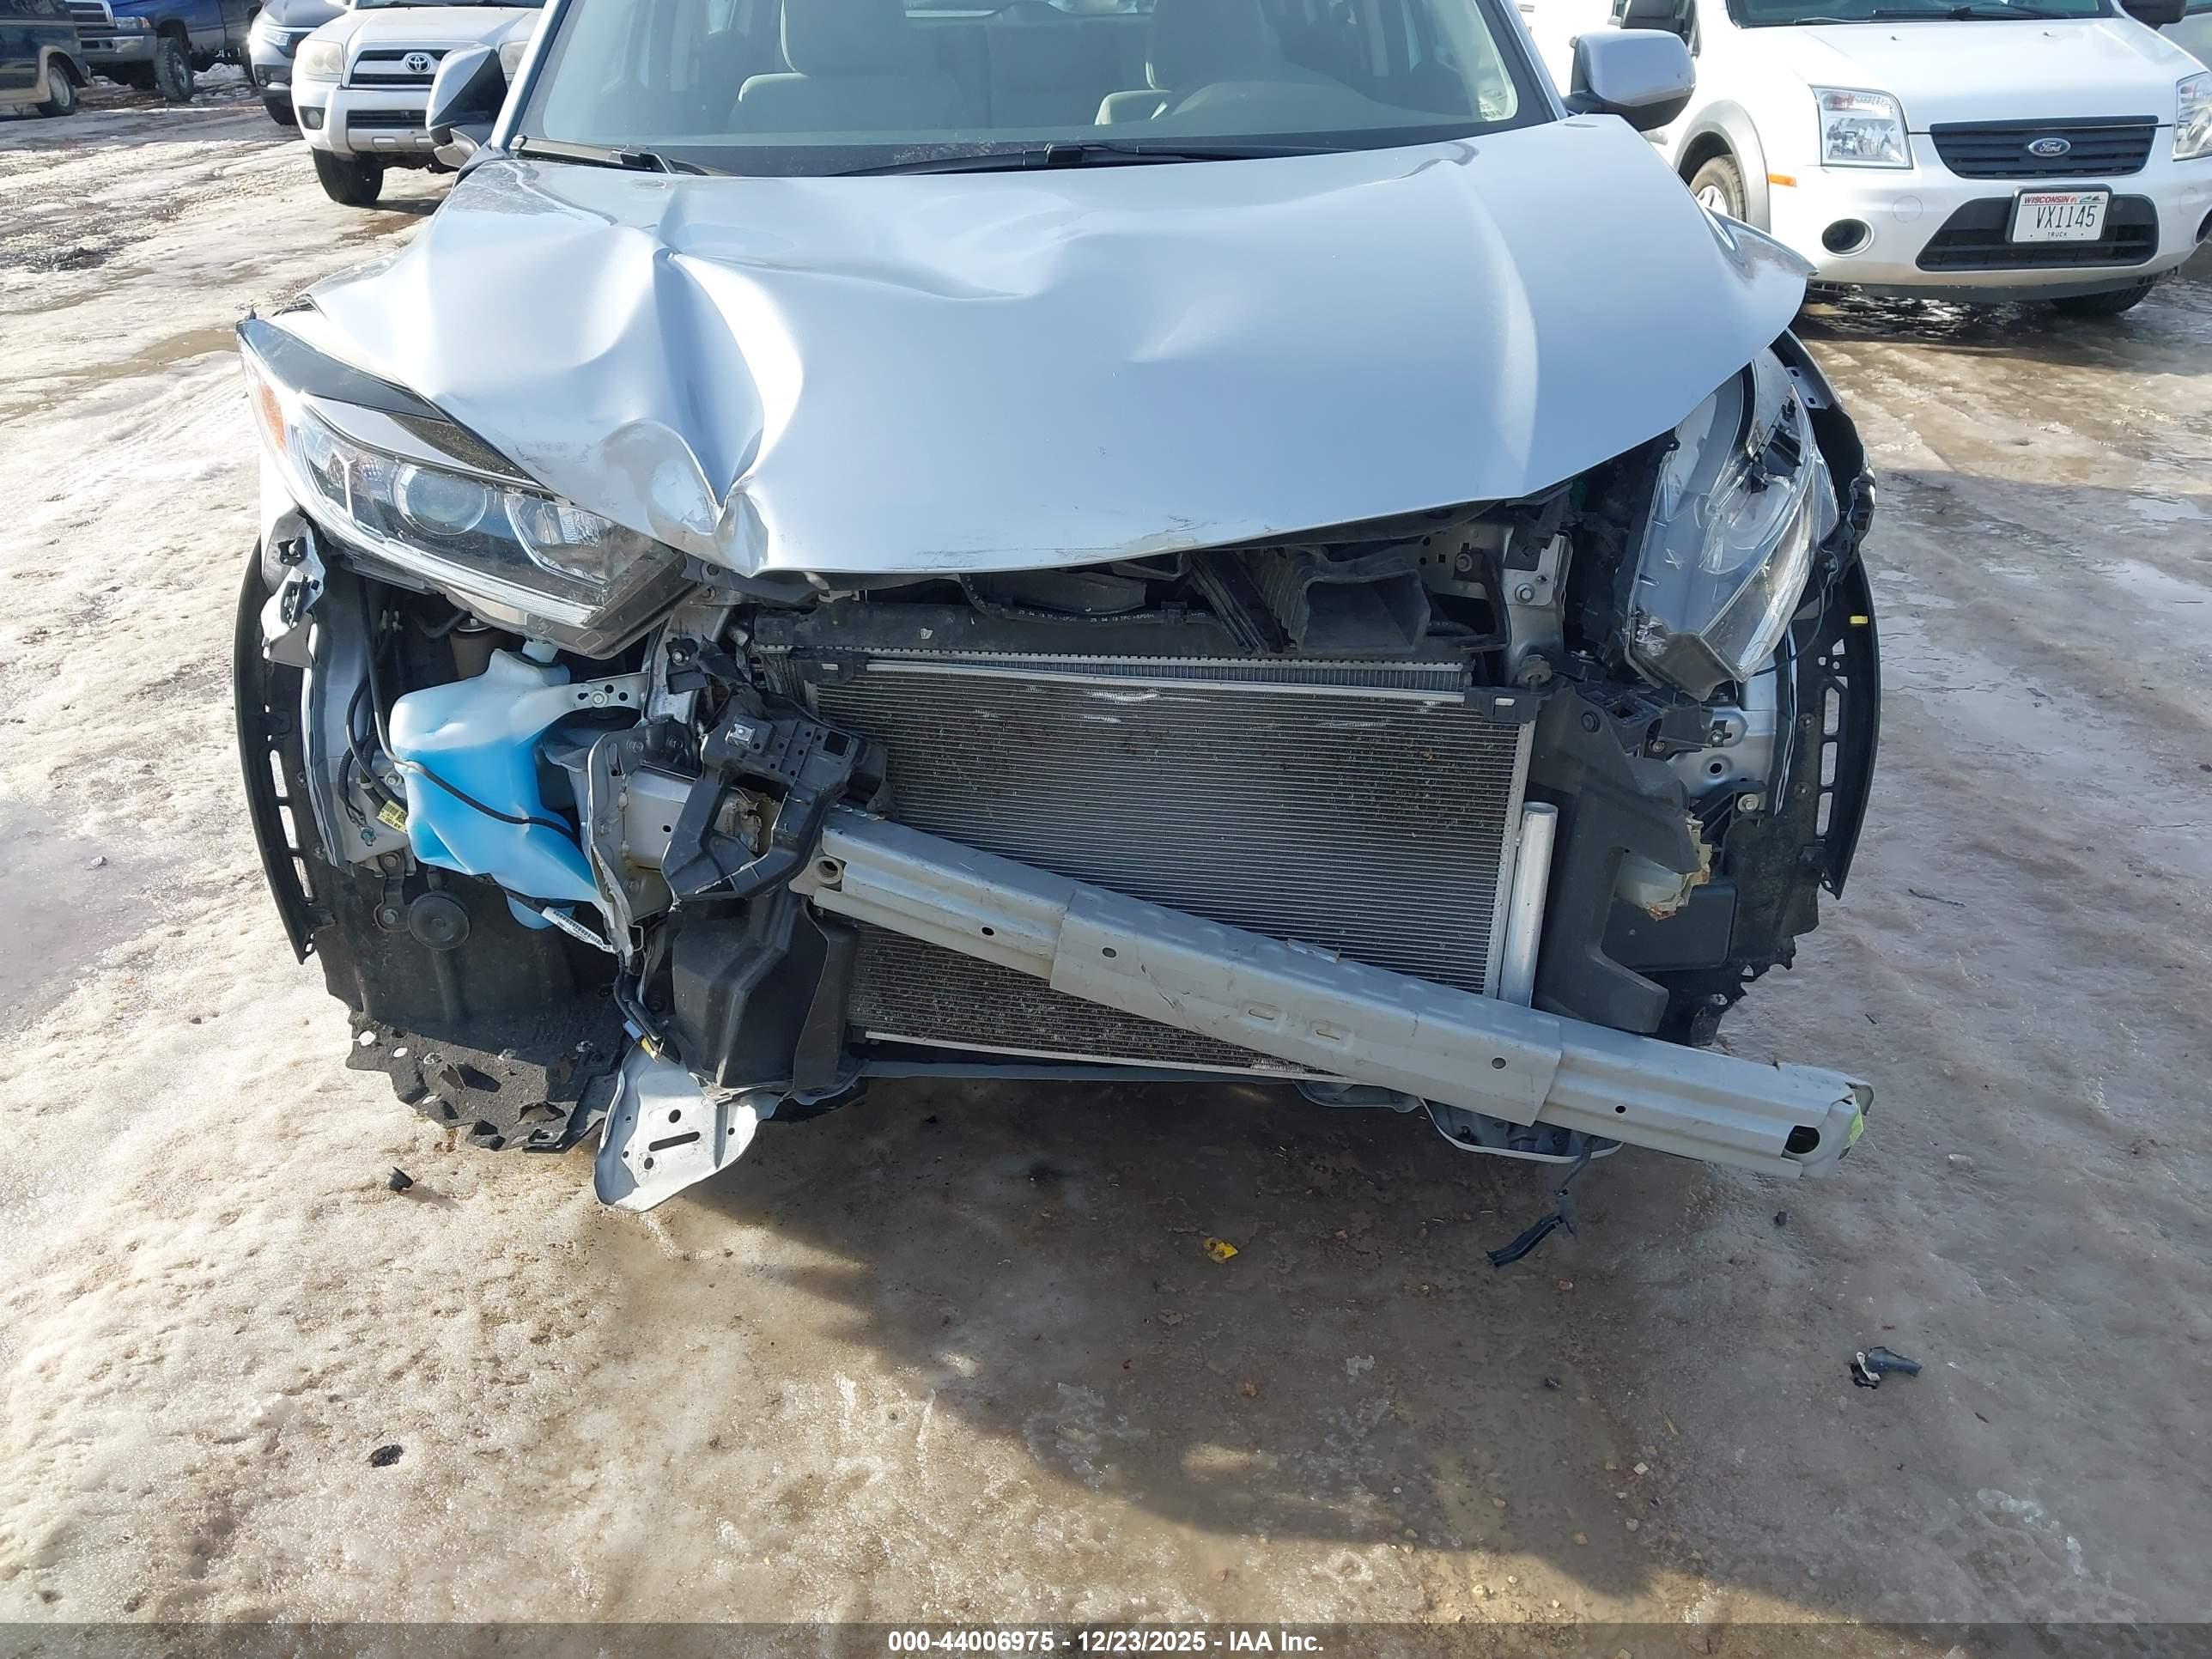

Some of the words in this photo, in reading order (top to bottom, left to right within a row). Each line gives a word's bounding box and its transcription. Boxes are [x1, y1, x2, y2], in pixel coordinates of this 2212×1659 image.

[2039, 141, 2062, 153] Ford
[2023, 196, 2070, 205] WISCONSIN
[2036, 205, 2098, 229] VX1145
